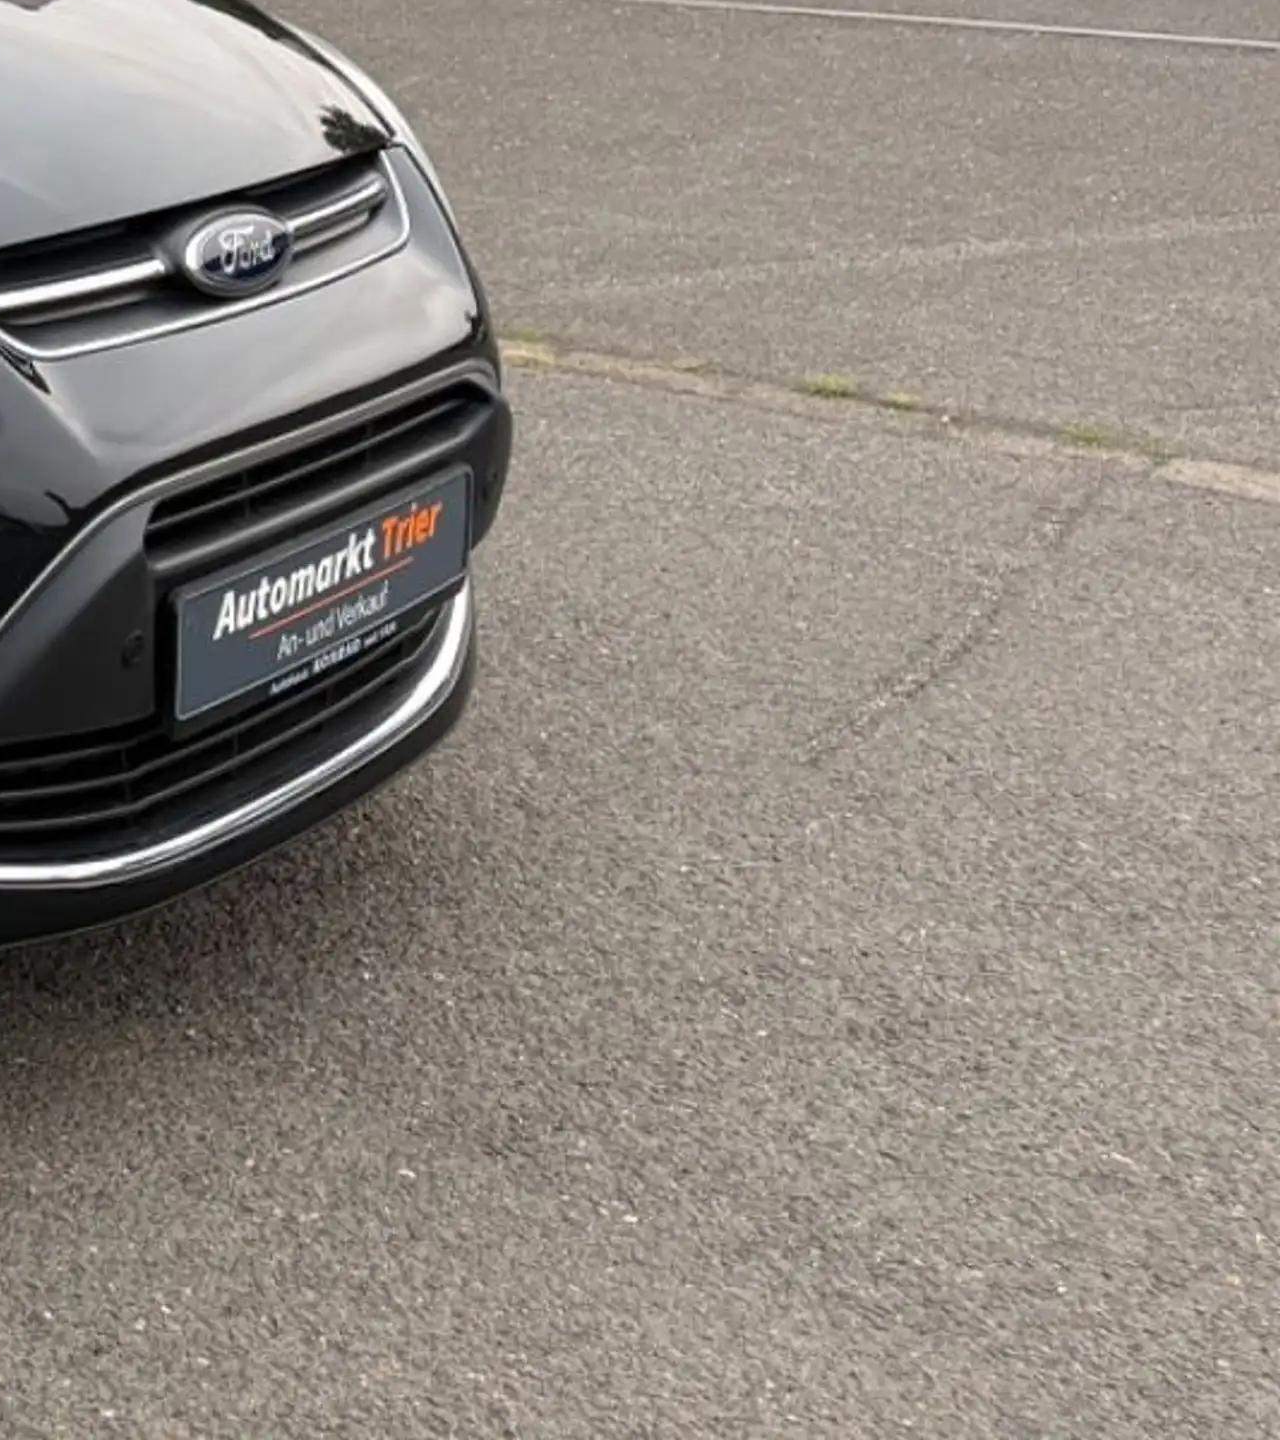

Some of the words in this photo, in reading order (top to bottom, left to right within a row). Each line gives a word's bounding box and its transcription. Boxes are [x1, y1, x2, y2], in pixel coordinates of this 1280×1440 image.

[219, 225, 277, 275] Ford
[212, 526, 377, 641] Automarkt
[382, 503, 444, 559] Trier
[276, 632, 305, 661] An-
[305, 607, 336, 647] und
[336, 578, 389, 629] Verkauf
